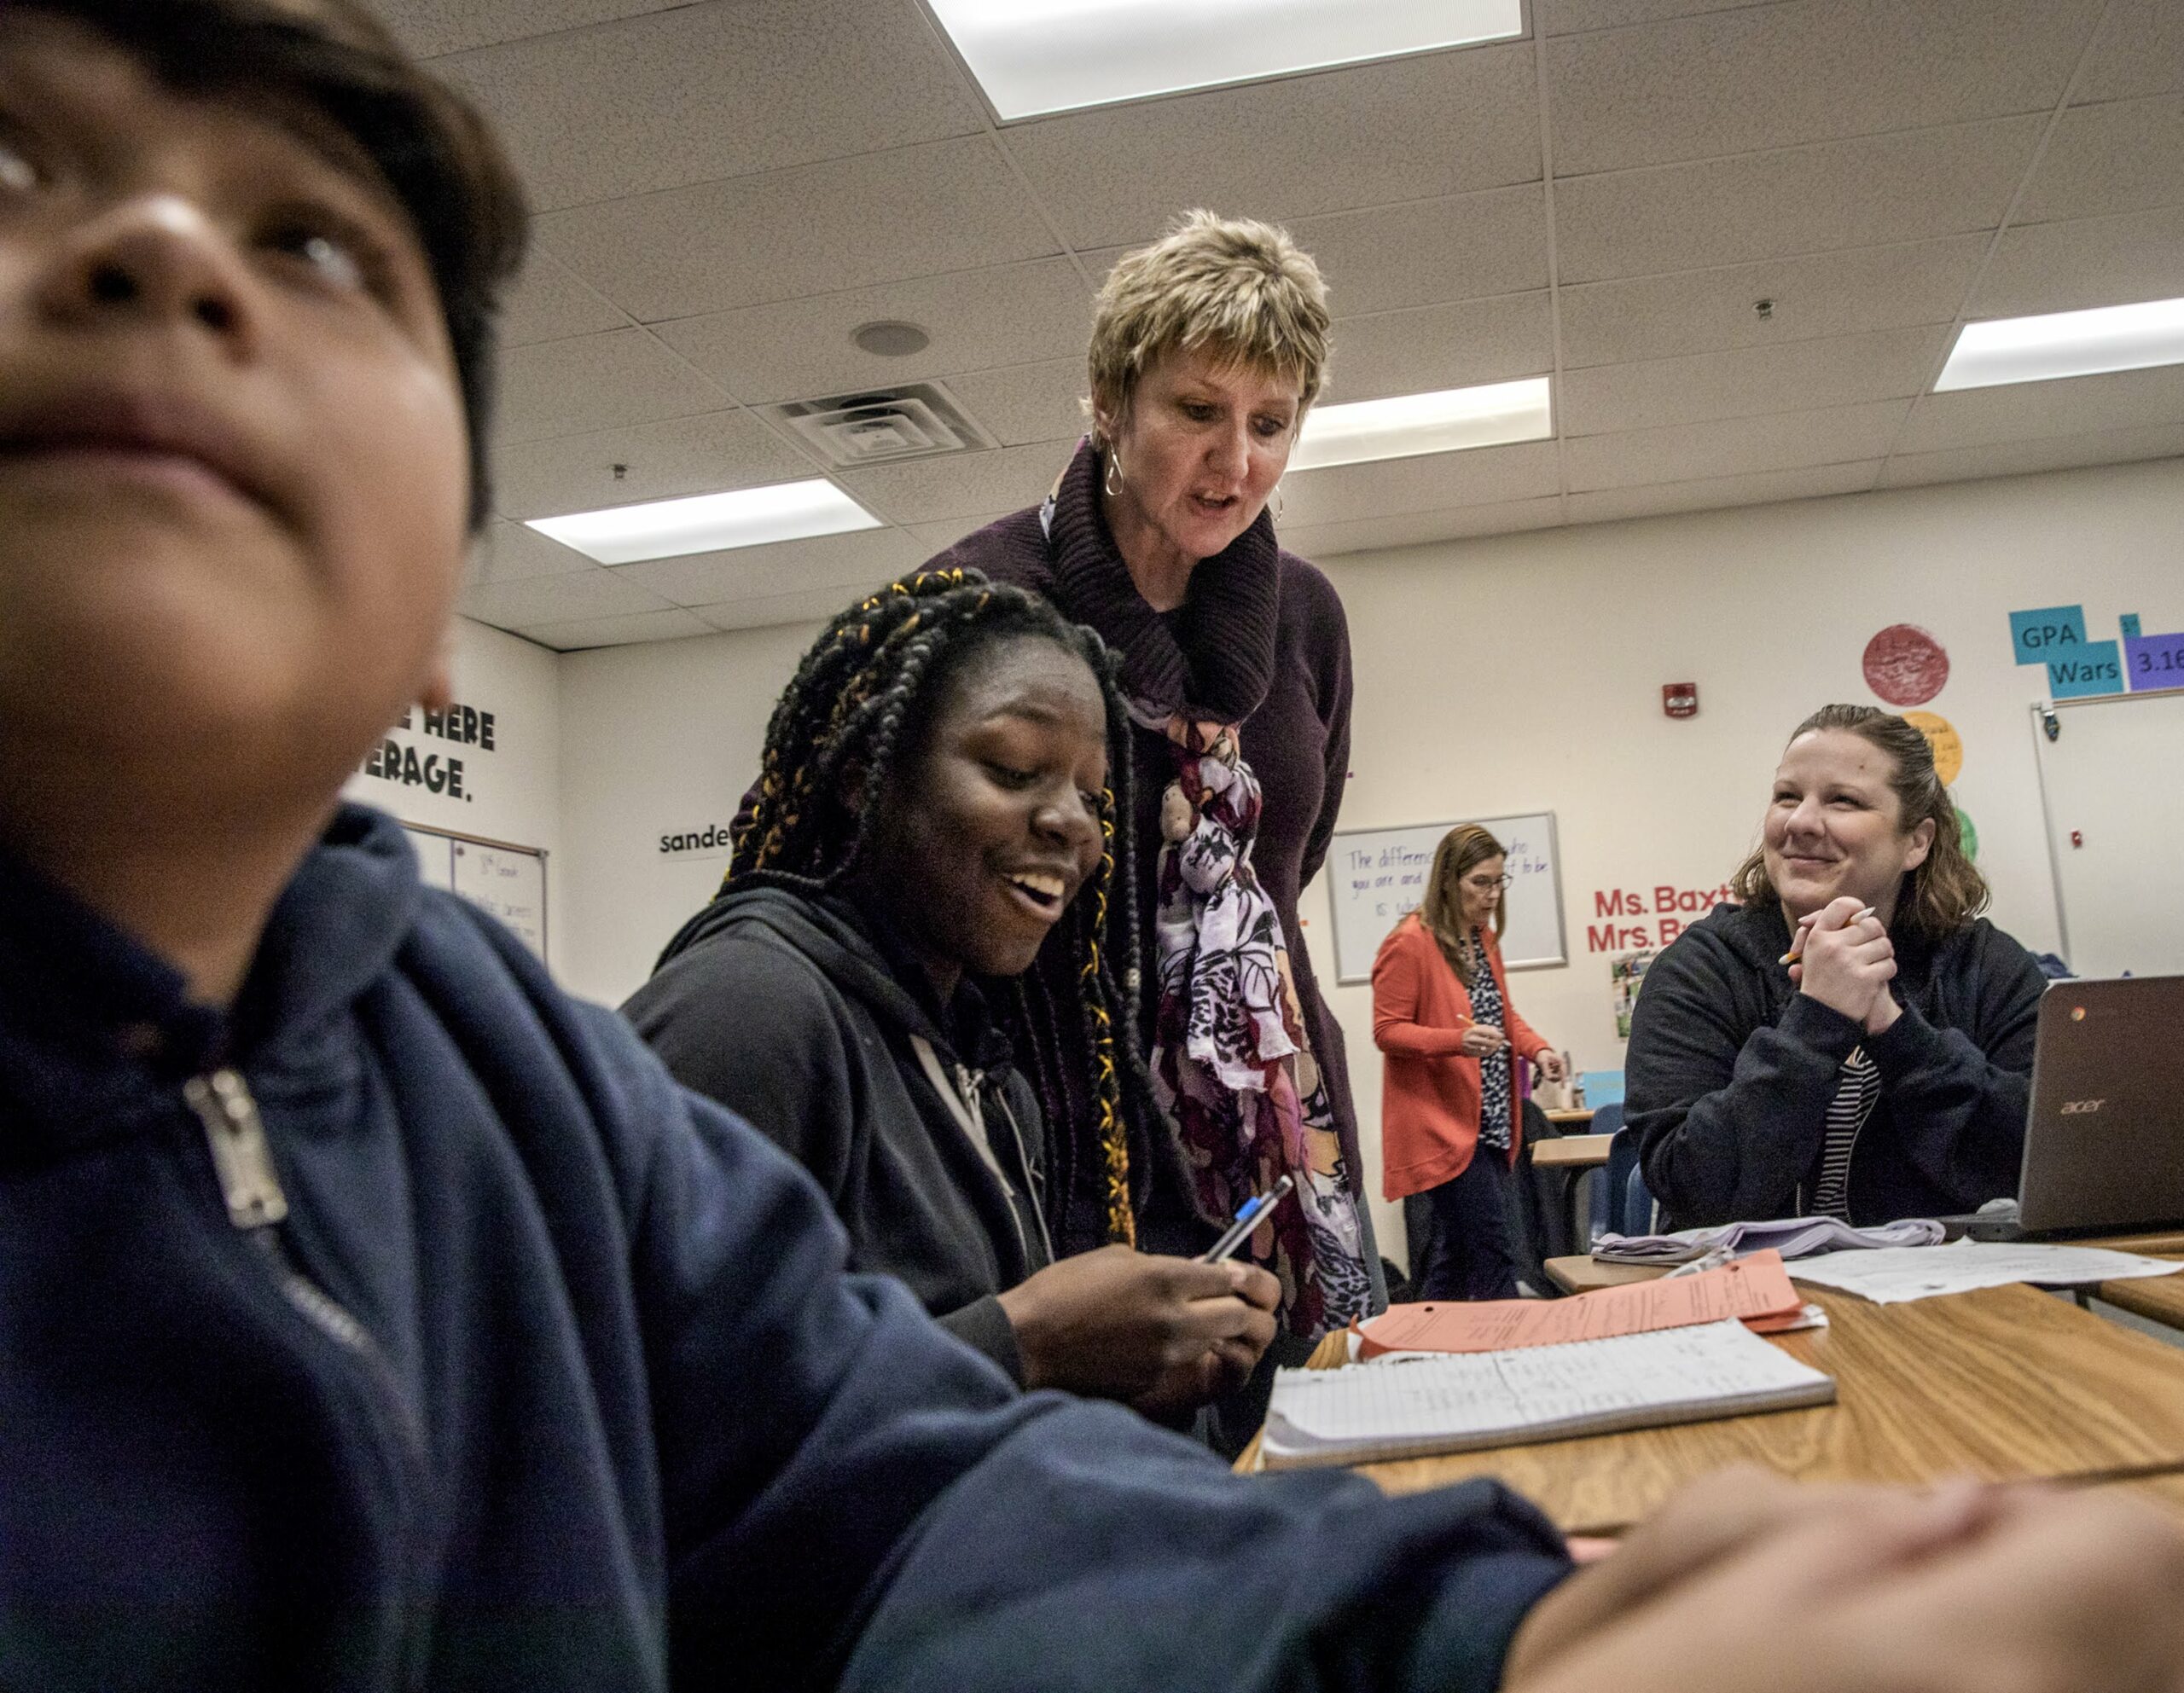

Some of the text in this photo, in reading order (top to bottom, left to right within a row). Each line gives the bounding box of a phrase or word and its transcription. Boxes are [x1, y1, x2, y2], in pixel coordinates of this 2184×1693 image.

[2022, 624, 2077, 648] GPA
[2050, 661, 2118, 684] Wars
[424, 703, 495, 751] HERE
[659, 824, 729, 853] sande
[1346, 849, 1372, 870] The
[1379, 845, 1434, 868] differenc
[1375, 876, 1393, 887] are
[1401, 872, 1422, 885] and
[1595, 884, 1734, 918] Ms. Baxt
[1588, 919, 1687, 953] Mrs. B
[2061, 1099, 2106, 1115] acer
